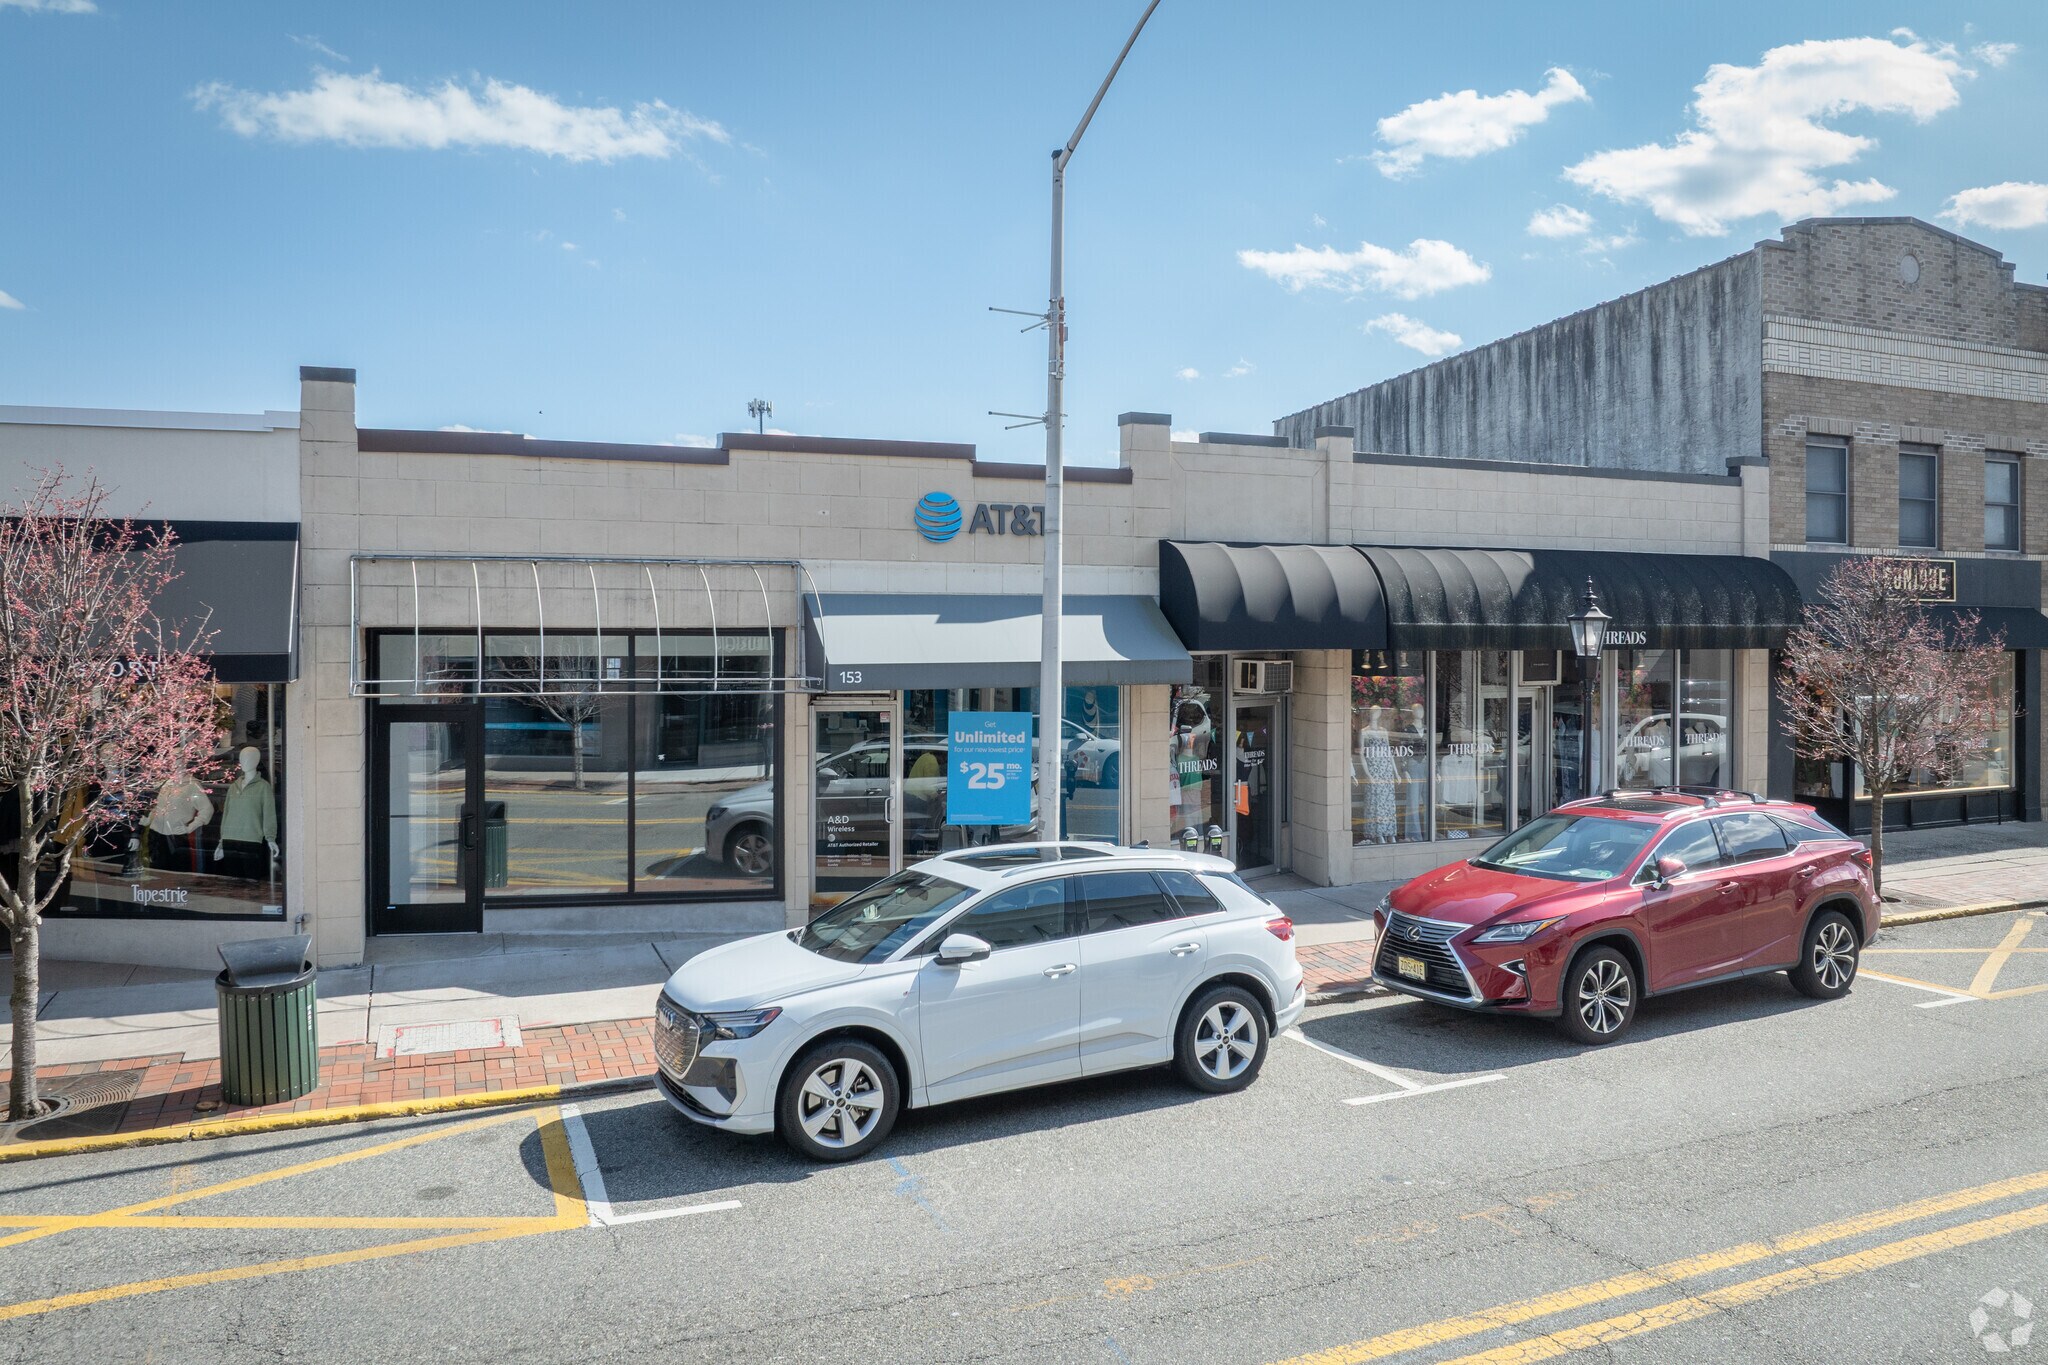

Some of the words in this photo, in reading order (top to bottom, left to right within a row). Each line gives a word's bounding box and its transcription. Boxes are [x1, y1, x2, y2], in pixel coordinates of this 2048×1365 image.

[969, 504, 1045, 536] AT&T
[77, 661, 158, 678] ORT
[840, 671, 862, 684] 153
[955, 731, 1025, 744] Unlimited
[1624, 735, 1665, 747] THREADS
[1685, 732, 1724, 744] THREADS
[1364, 745, 1414, 758] THREADS
[1448, 743, 1495, 755] THREADS
[1178, 757, 1217, 773] THREADS
[960, 761, 1005, 790] $25
[828, 815, 850, 824] A&D
[131, 884, 188, 906] Tapestrie
